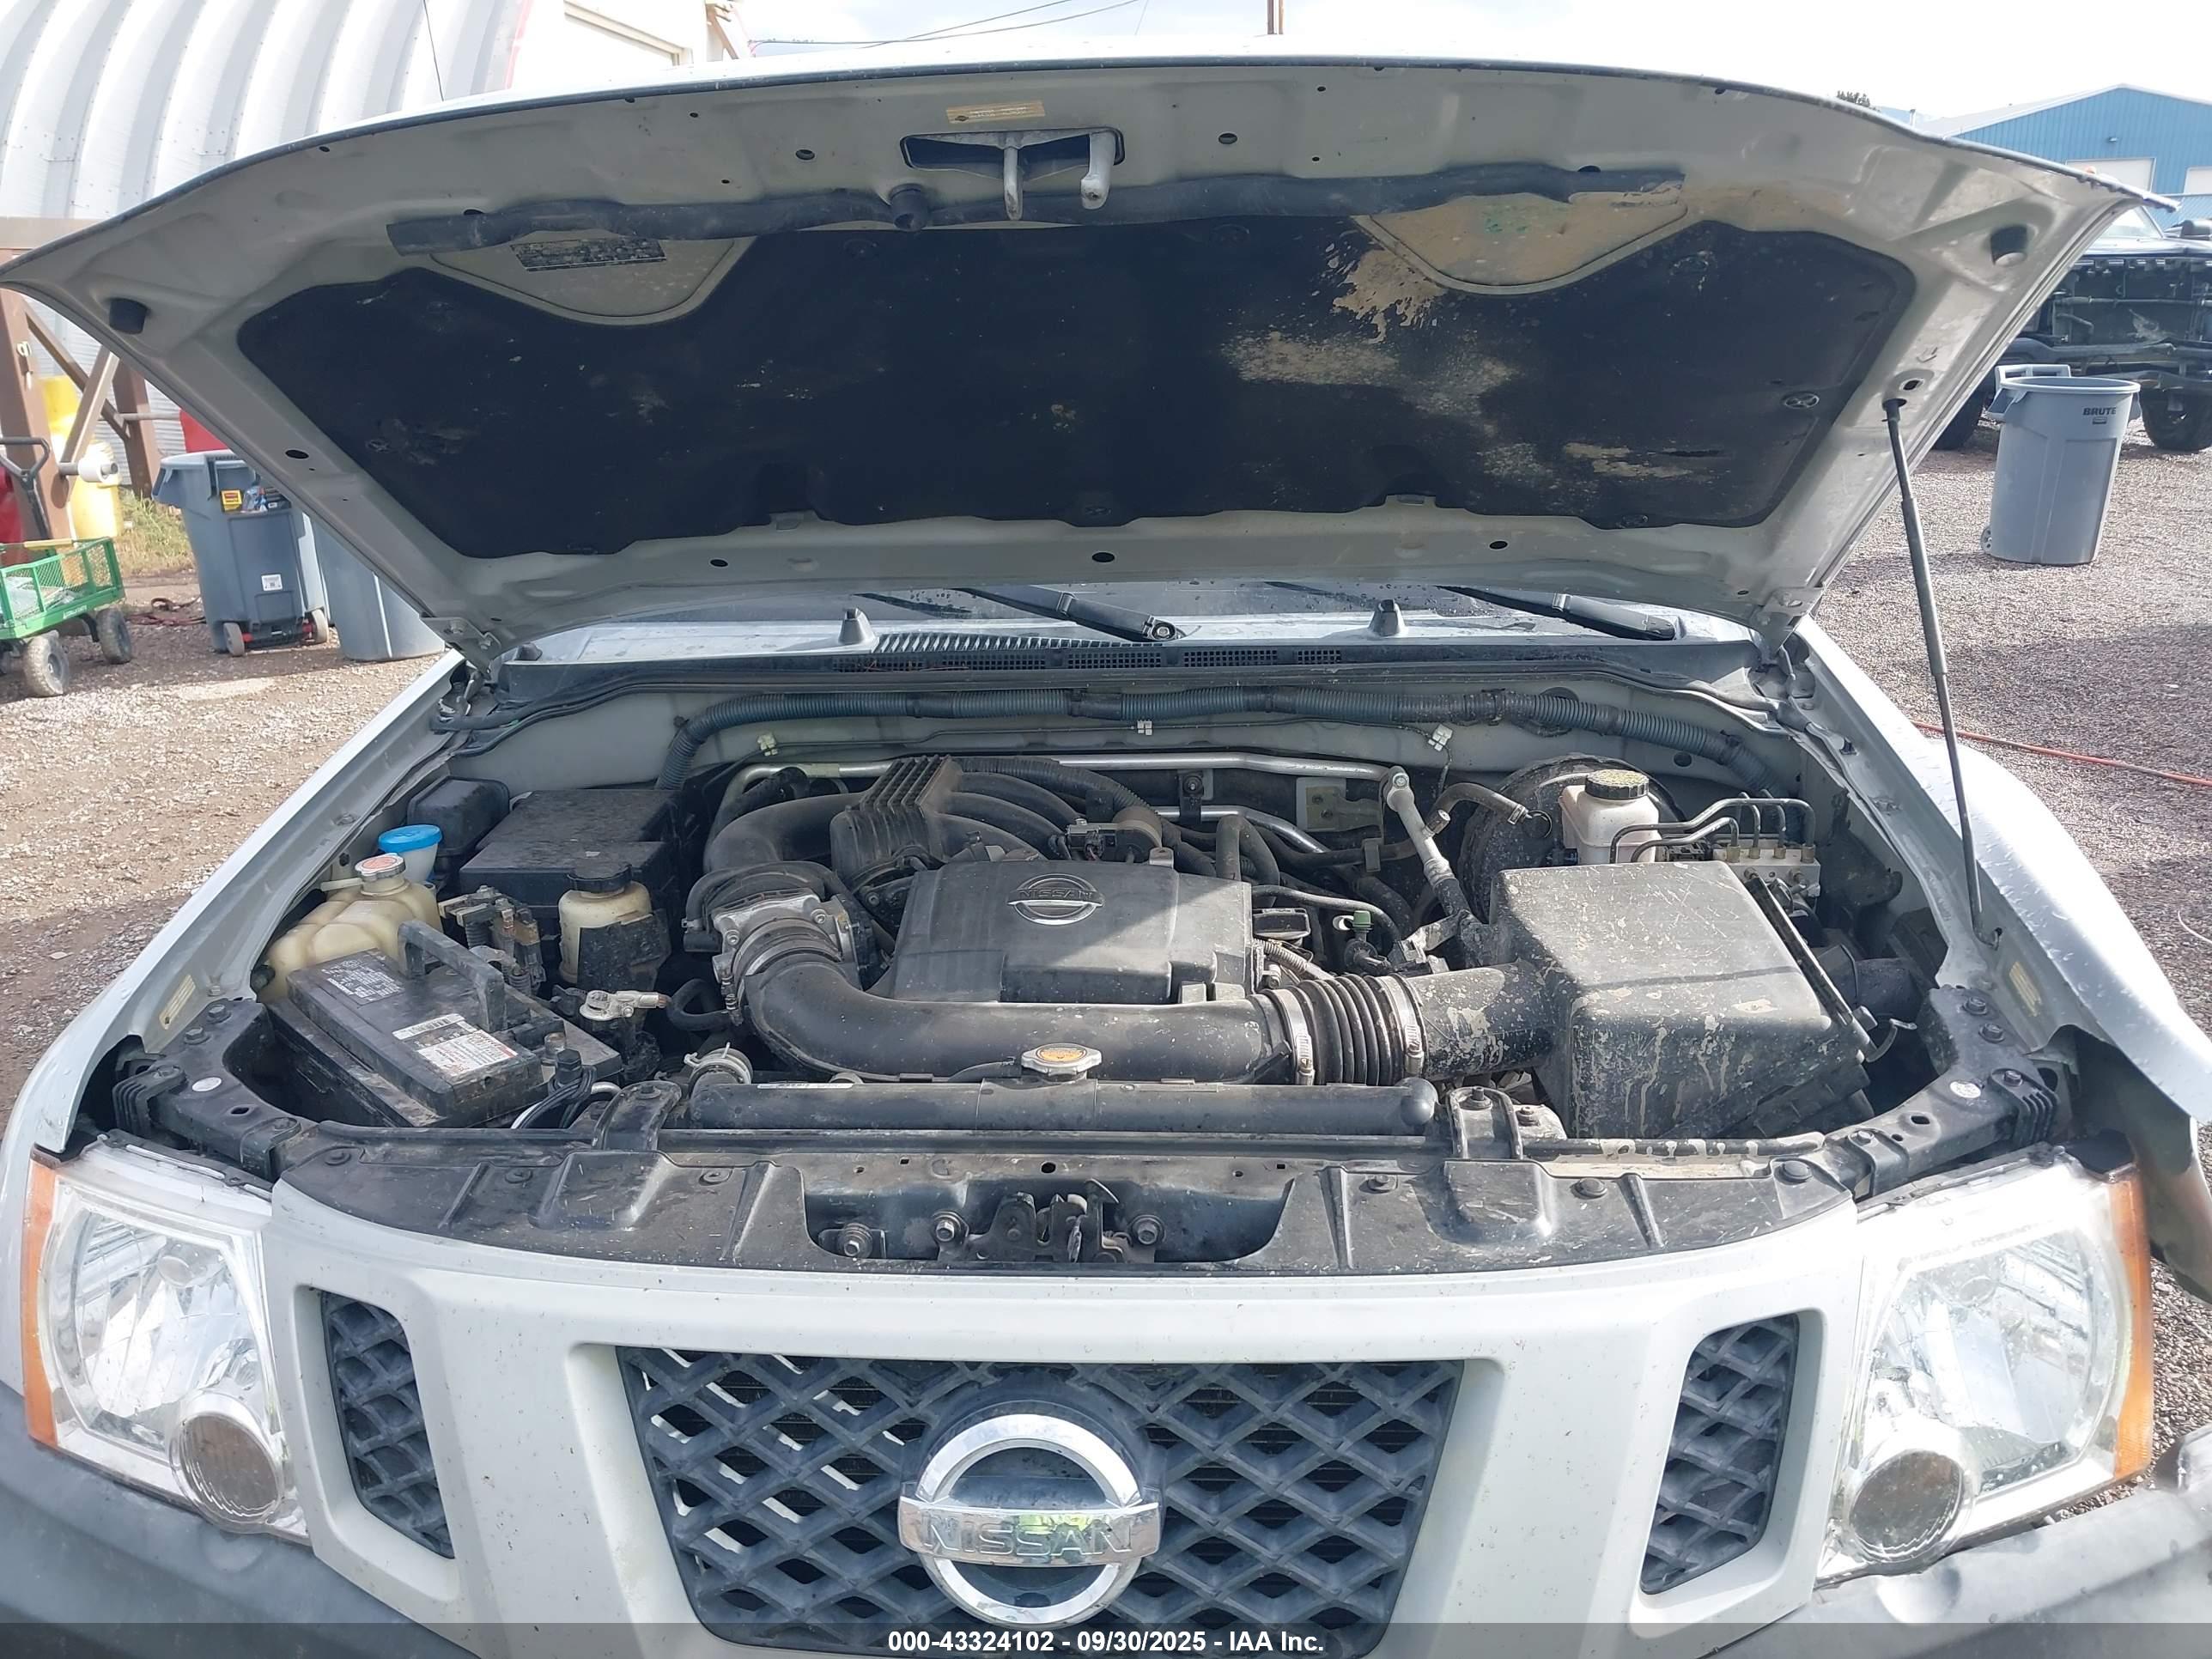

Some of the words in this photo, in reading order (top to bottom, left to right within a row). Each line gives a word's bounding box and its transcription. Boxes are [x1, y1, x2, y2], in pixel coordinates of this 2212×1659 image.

[2082, 407, 2117, 416] BRUTE
[1017, 888, 1093, 900] NISSAN
[922, 1513, 1133, 1557] NISSAN
